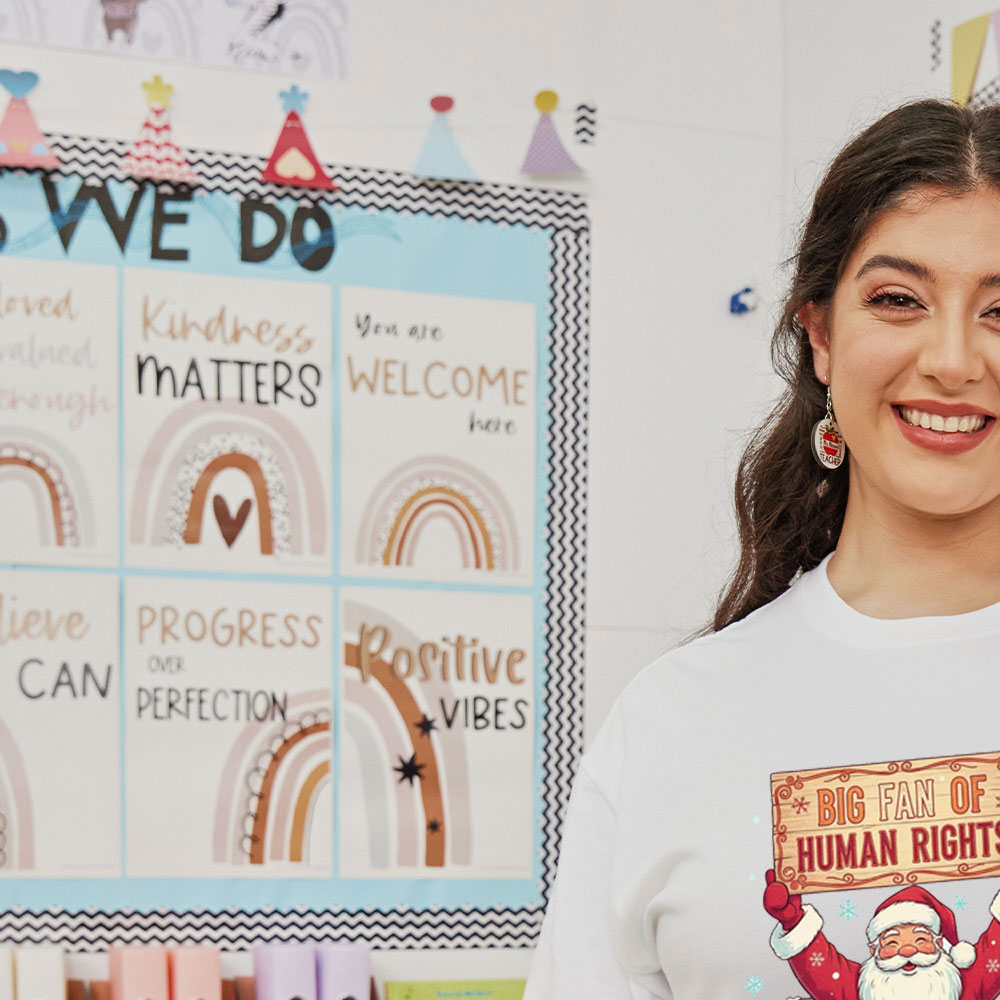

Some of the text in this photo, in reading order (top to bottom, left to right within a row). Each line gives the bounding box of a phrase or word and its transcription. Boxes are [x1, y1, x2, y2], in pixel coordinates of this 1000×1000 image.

[41, 175, 194, 262] WE
[240, 195, 335, 273] DO
[0, 281, 78, 321] oved
[141, 294, 318, 354] Kindness
[355, 312, 445, 342] You are
[0, 332, 98, 369] alued
[346, 354, 530, 406] WELCOME
[469, 410, 519, 435] here
[138, 605, 324, 649] PROGRESS
[149, 655, 186, 674] OVER
[359, 623, 527, 685] Positive
[18, 657, 113, 700] CAN
[137, 686, 289, 722] PERFECTION
[439, 695, 530, 731] VIBES
[816, 774, 987, 827] BIG FAN OF
[796, 829, 898, 873] HUMAN
